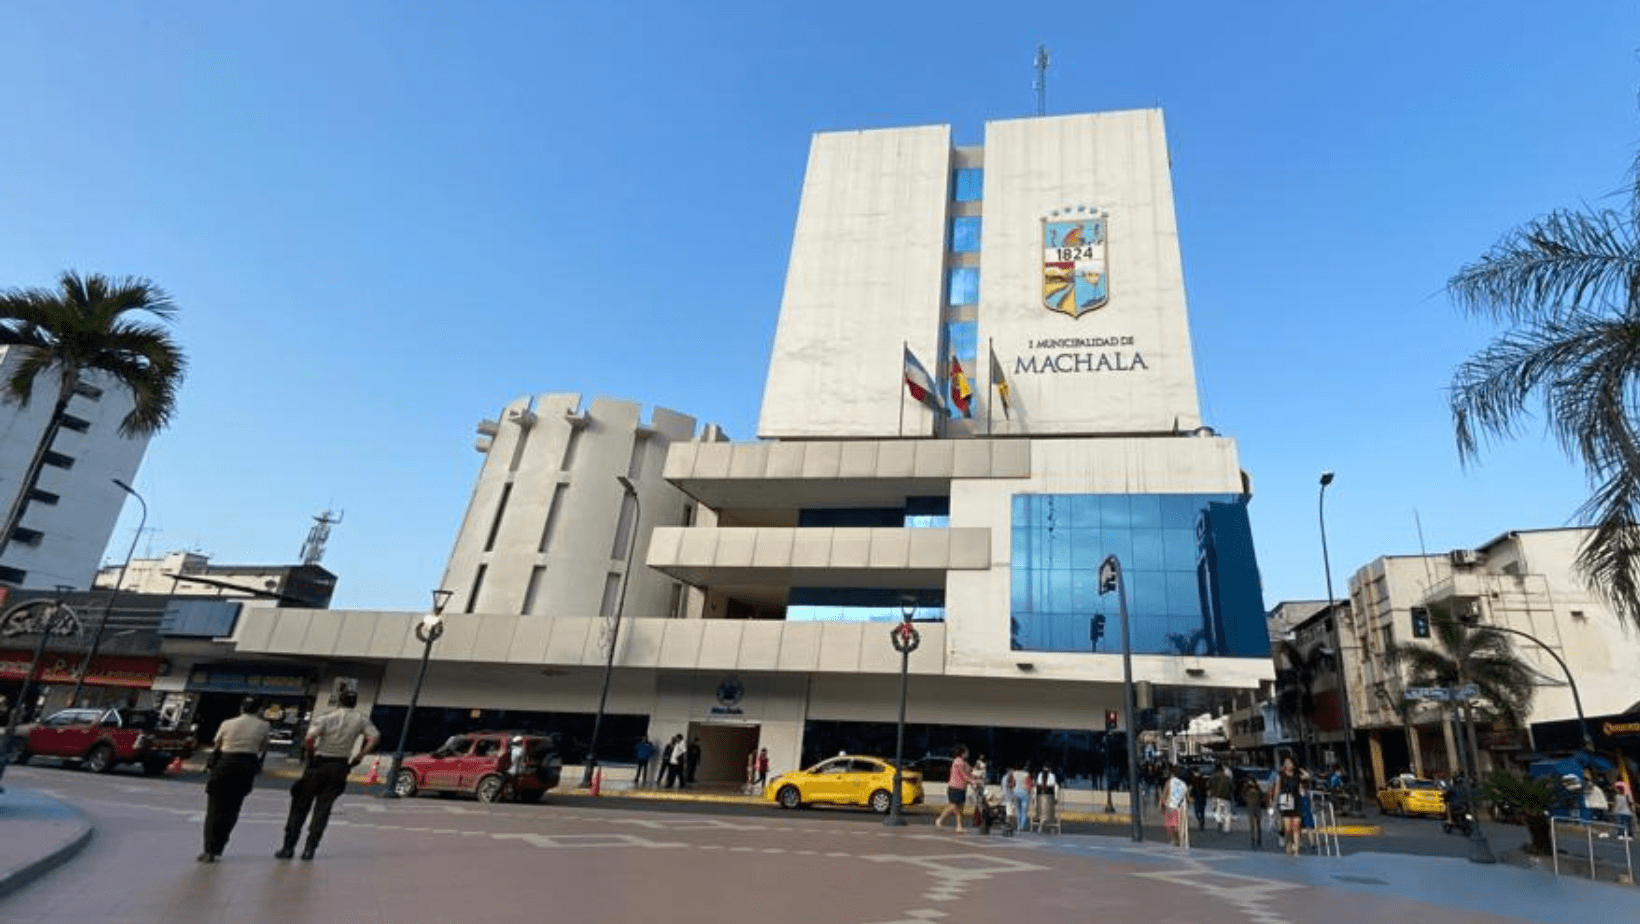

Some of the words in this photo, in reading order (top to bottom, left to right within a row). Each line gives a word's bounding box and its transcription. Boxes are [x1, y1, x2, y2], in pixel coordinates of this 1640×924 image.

[1056, 247, 1093, 261] 1824
[1036, 336, 1119, 348] MUNICIPALIDAD
[1120, 335, 1134, 345] DE
[1014, 351, 1149, 374] MACHALA
